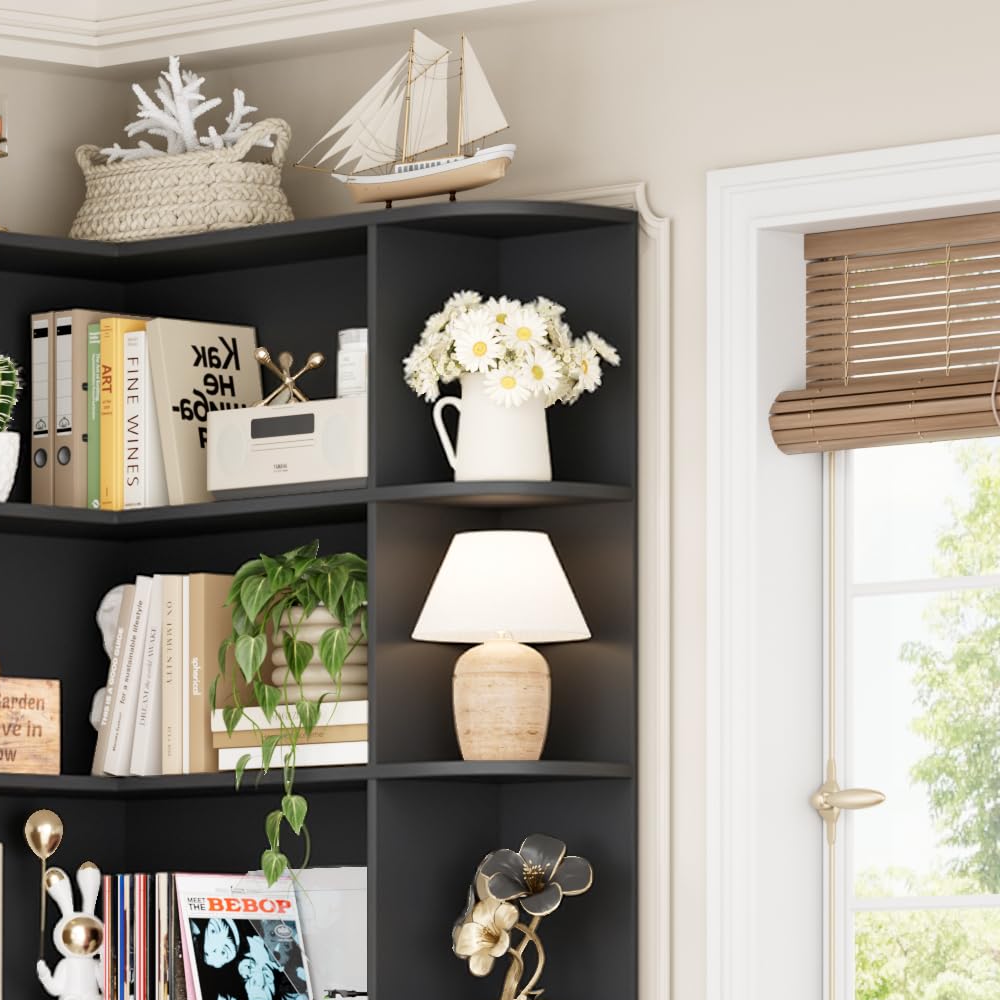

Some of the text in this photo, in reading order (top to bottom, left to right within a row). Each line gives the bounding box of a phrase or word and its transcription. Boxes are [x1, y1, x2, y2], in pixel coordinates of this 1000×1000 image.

[102, 364, 112, 394] ART
[127, 357, 140, 406] FINE
[127, 414, 140, 488] WINES
[124, 634, 137, 683] sustainable
[133, 600, 144, 633] lifestyle
[109, 657, 119, 686] GOOD
[26, 719, 43, 738] in
[189, 897, 291, 914] THE BEBOP
